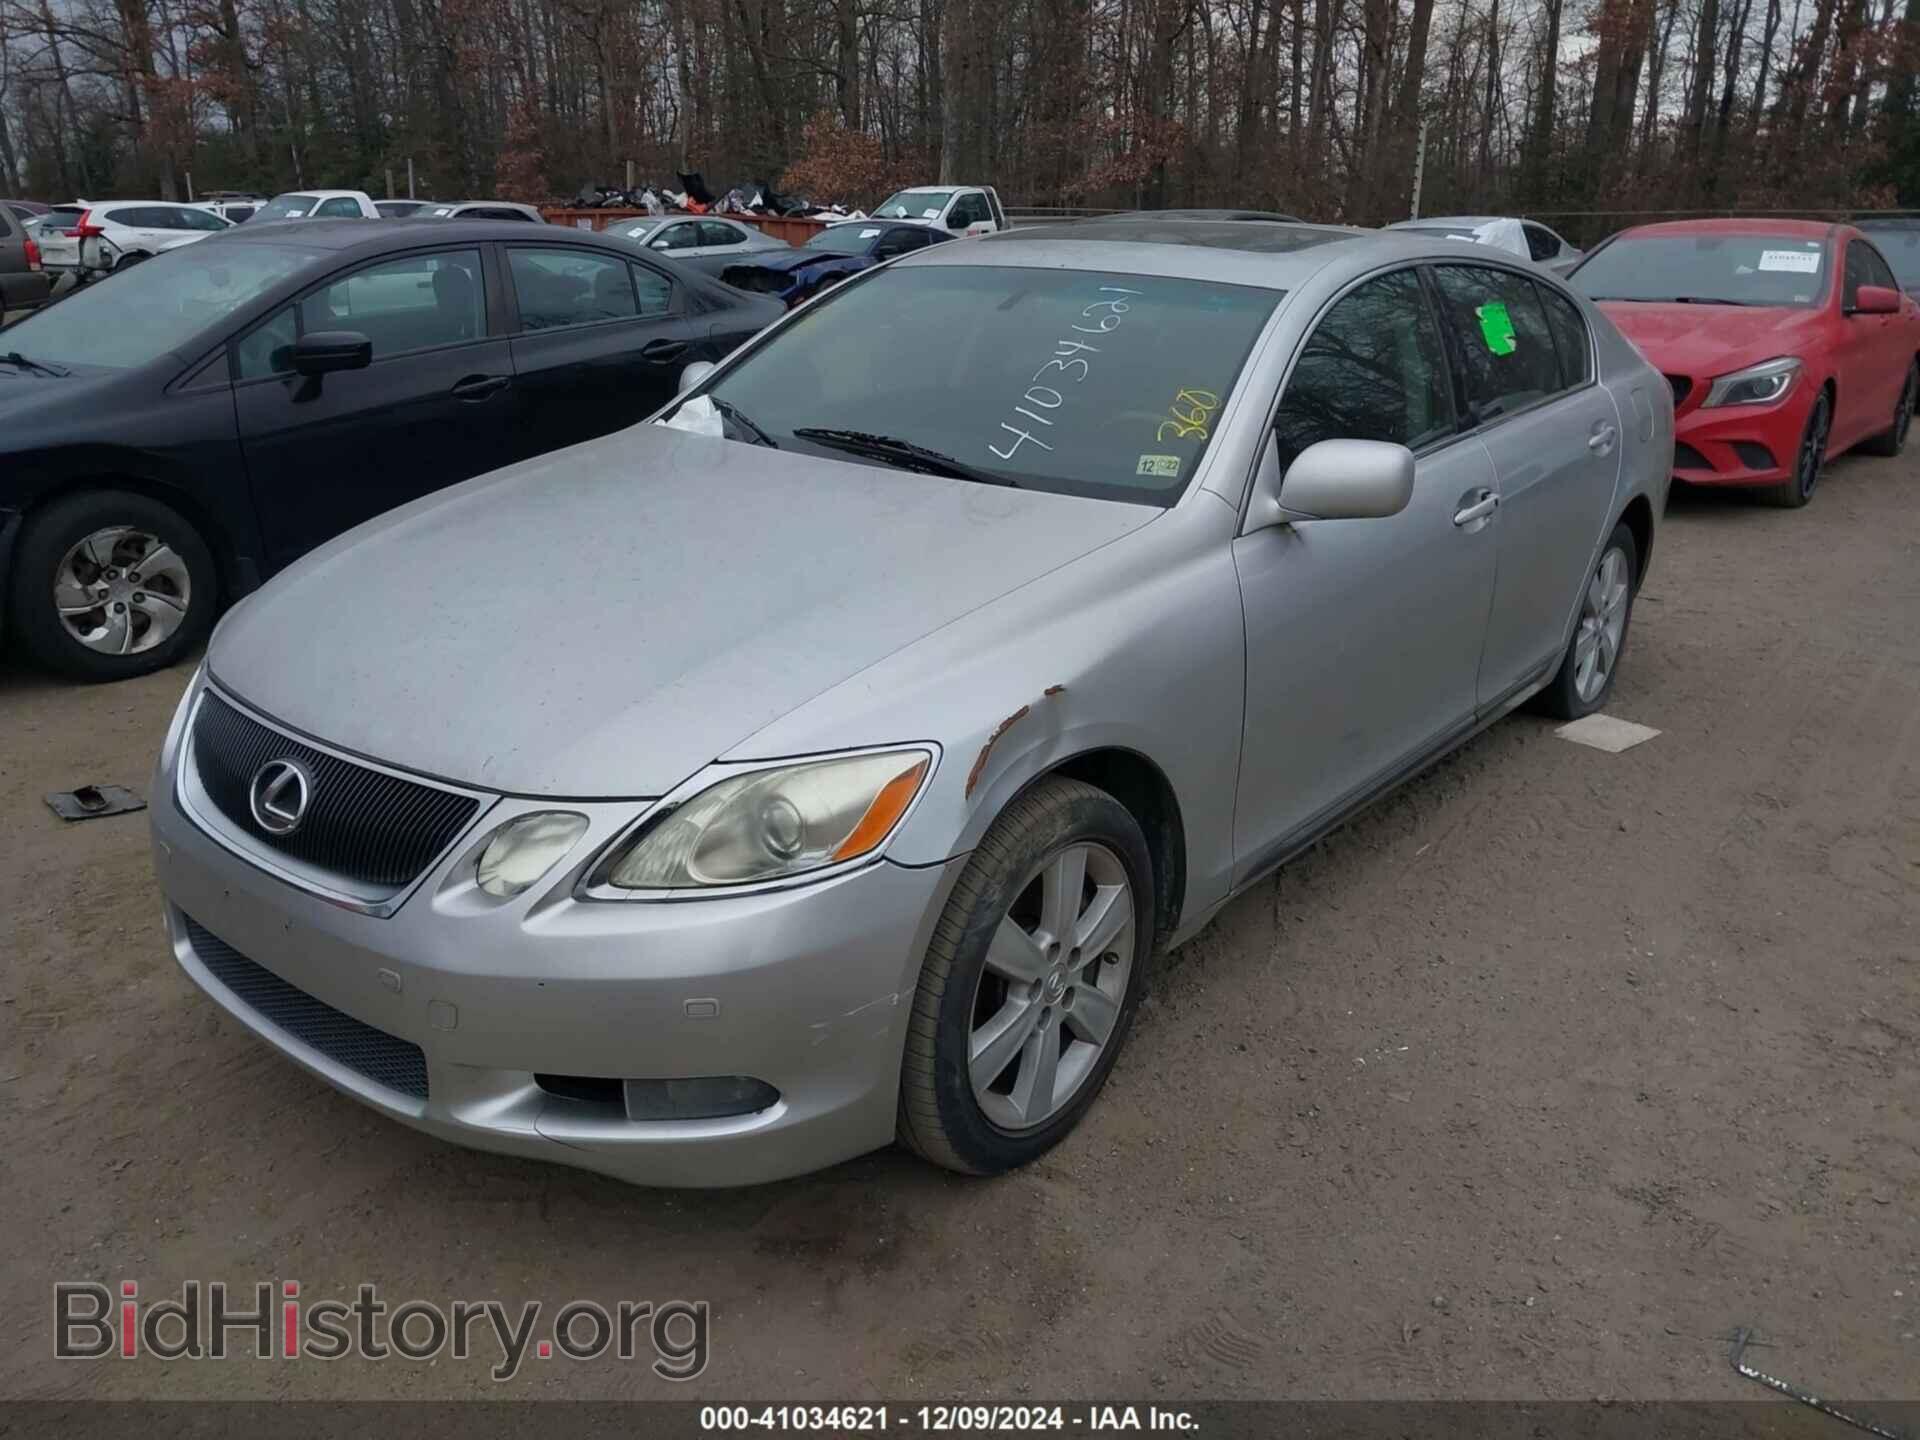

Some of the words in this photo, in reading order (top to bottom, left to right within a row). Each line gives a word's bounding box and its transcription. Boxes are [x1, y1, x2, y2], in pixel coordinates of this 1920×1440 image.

[988, 286, 1145, 460] 41034621
[1157, 388, 1221, 442] 360
[1142, 460, 1155, 473] 12
